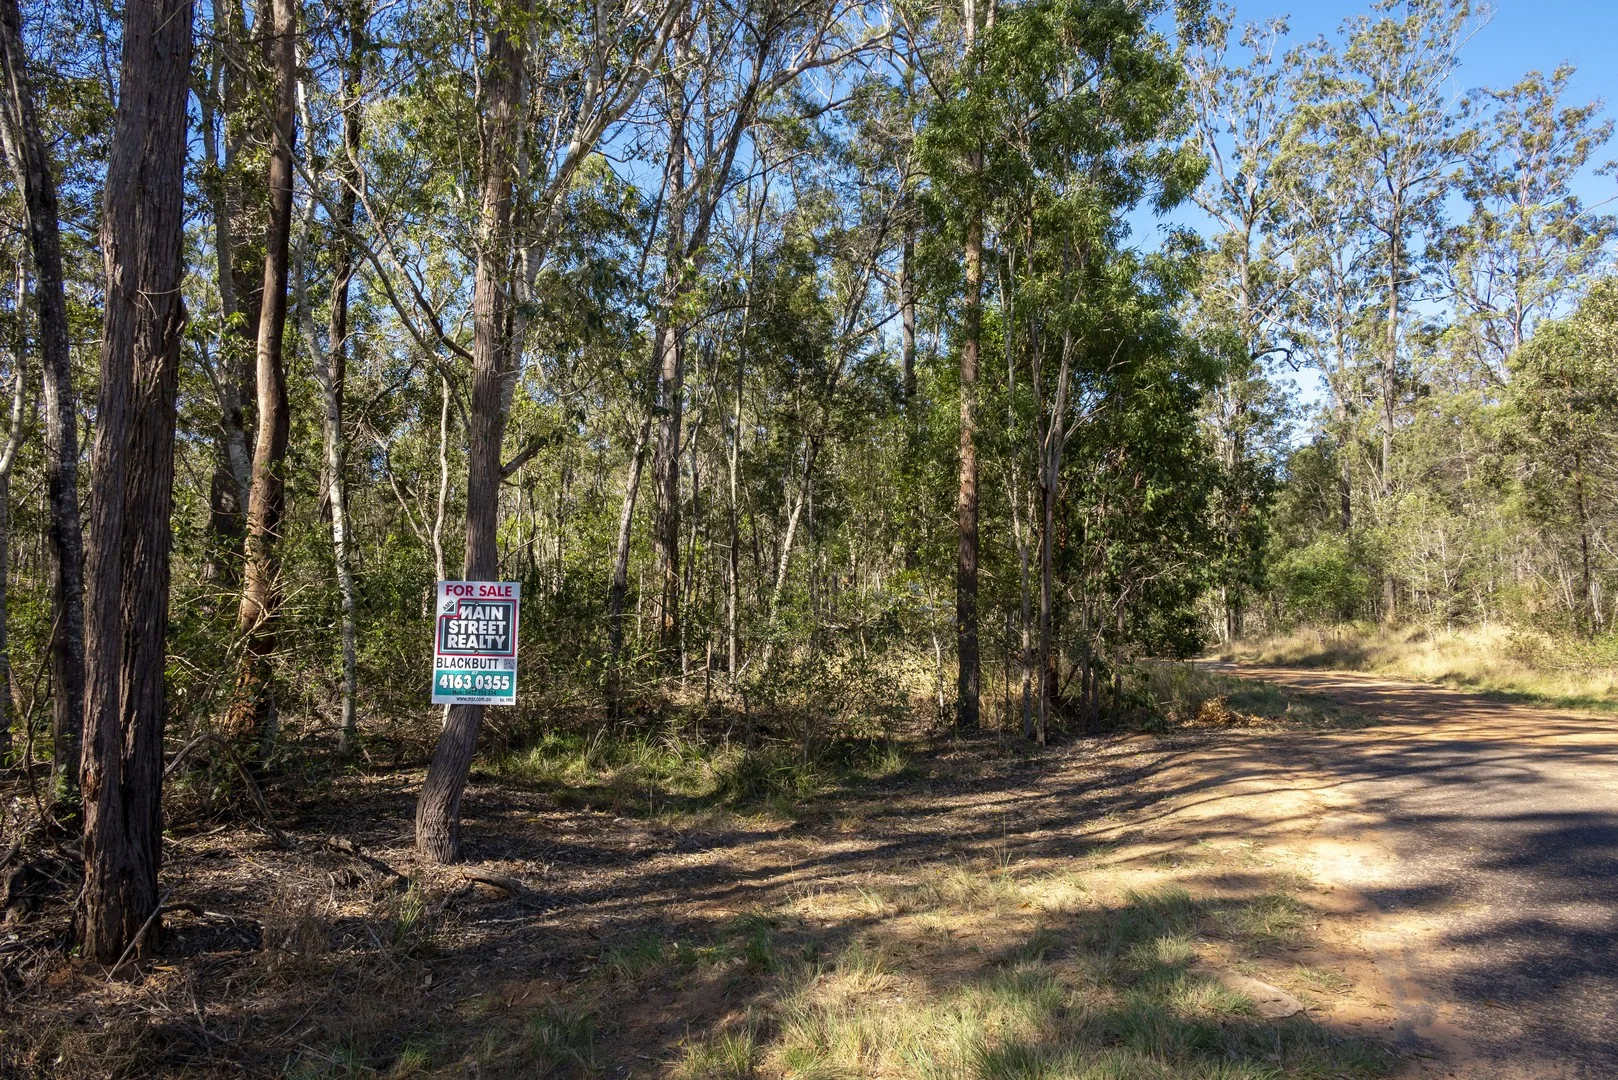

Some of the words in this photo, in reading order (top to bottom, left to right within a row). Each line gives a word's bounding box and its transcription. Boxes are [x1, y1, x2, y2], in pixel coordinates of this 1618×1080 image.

[445, 585, 474, 596] FOR
[479, 585, 512, 597] SALE
[454, 606, 504, 620] MAIN
[448, 620, 506, 634] STREET
[447, 635, 506, 649] REALTY
[436, 657, 499, 669] BLACKBUTT
[439, 674, 472, 689] 4163
[475, 675, 510, 690] 0355
